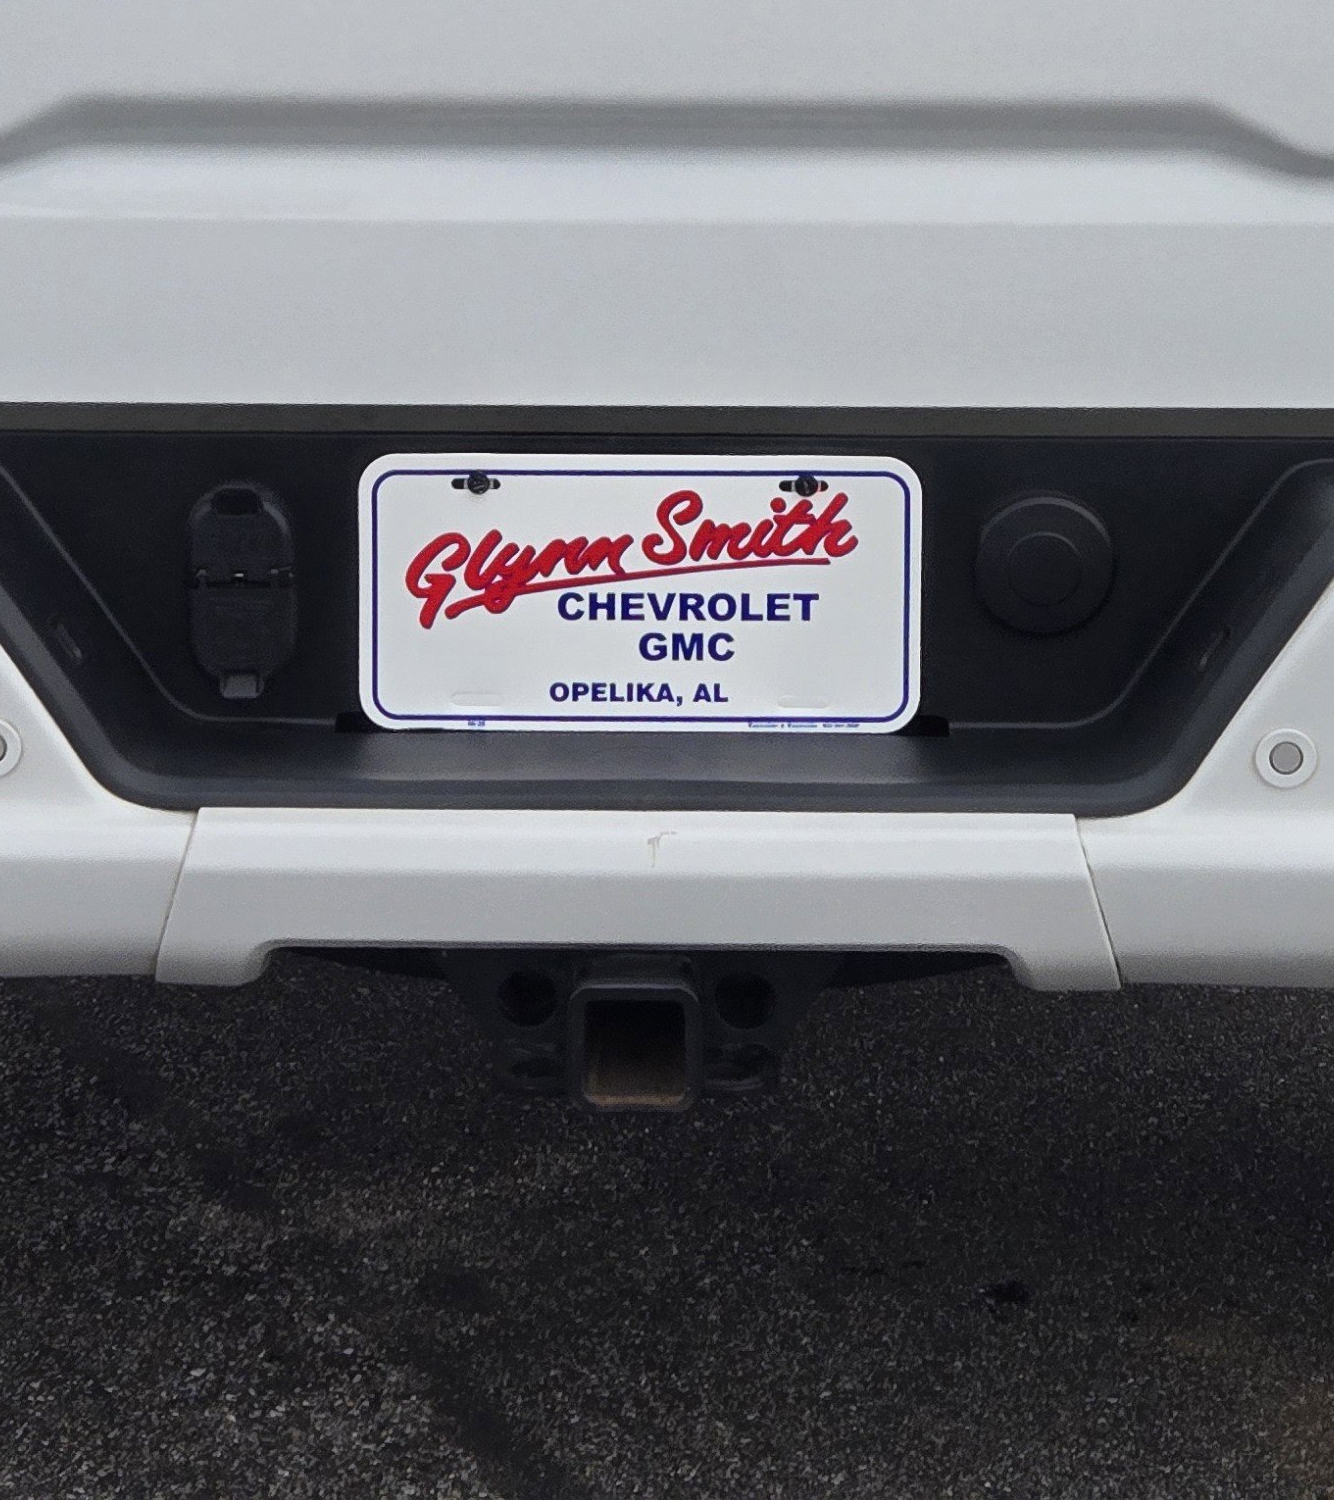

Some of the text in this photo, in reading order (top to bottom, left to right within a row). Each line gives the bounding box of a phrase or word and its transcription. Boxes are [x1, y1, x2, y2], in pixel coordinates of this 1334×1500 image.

[405, 489, 860, 630] Glynn Smith
[556, 591, 820, 622] CHEVROLET
[637, 632, 736, 662] GMC
[548, 682, 729, 707] OPELIKA, AL
